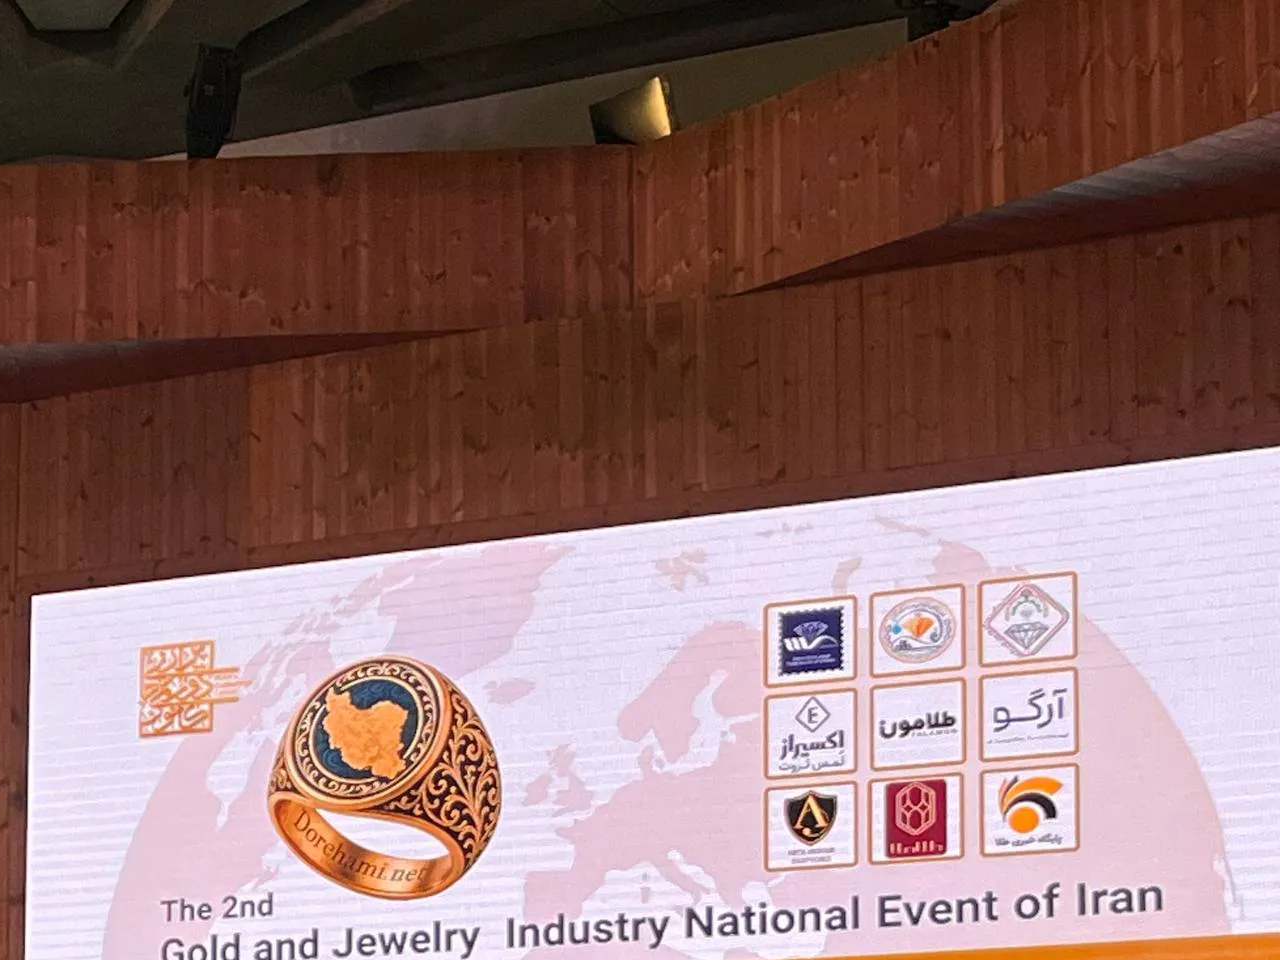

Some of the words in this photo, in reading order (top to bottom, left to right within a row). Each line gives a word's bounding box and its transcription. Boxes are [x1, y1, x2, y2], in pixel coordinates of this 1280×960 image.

[879, 711, 957, 739] طلامون
[993, 688, 1068, 732] آرگو
[779, 730, 844, 760] اکسیراز
[161, 899, 212, 923] The
[222, 893, 274, 918] 2nd
[333, 920, 480, 960] Jewelry
[506, 911, 670, 950] Industry
[685, 896, 860, 939] National
[878, 889, 999, 928] Event
[1014, 883, 1060, 920] of
[1077, 882, 1164, 917] Iran
